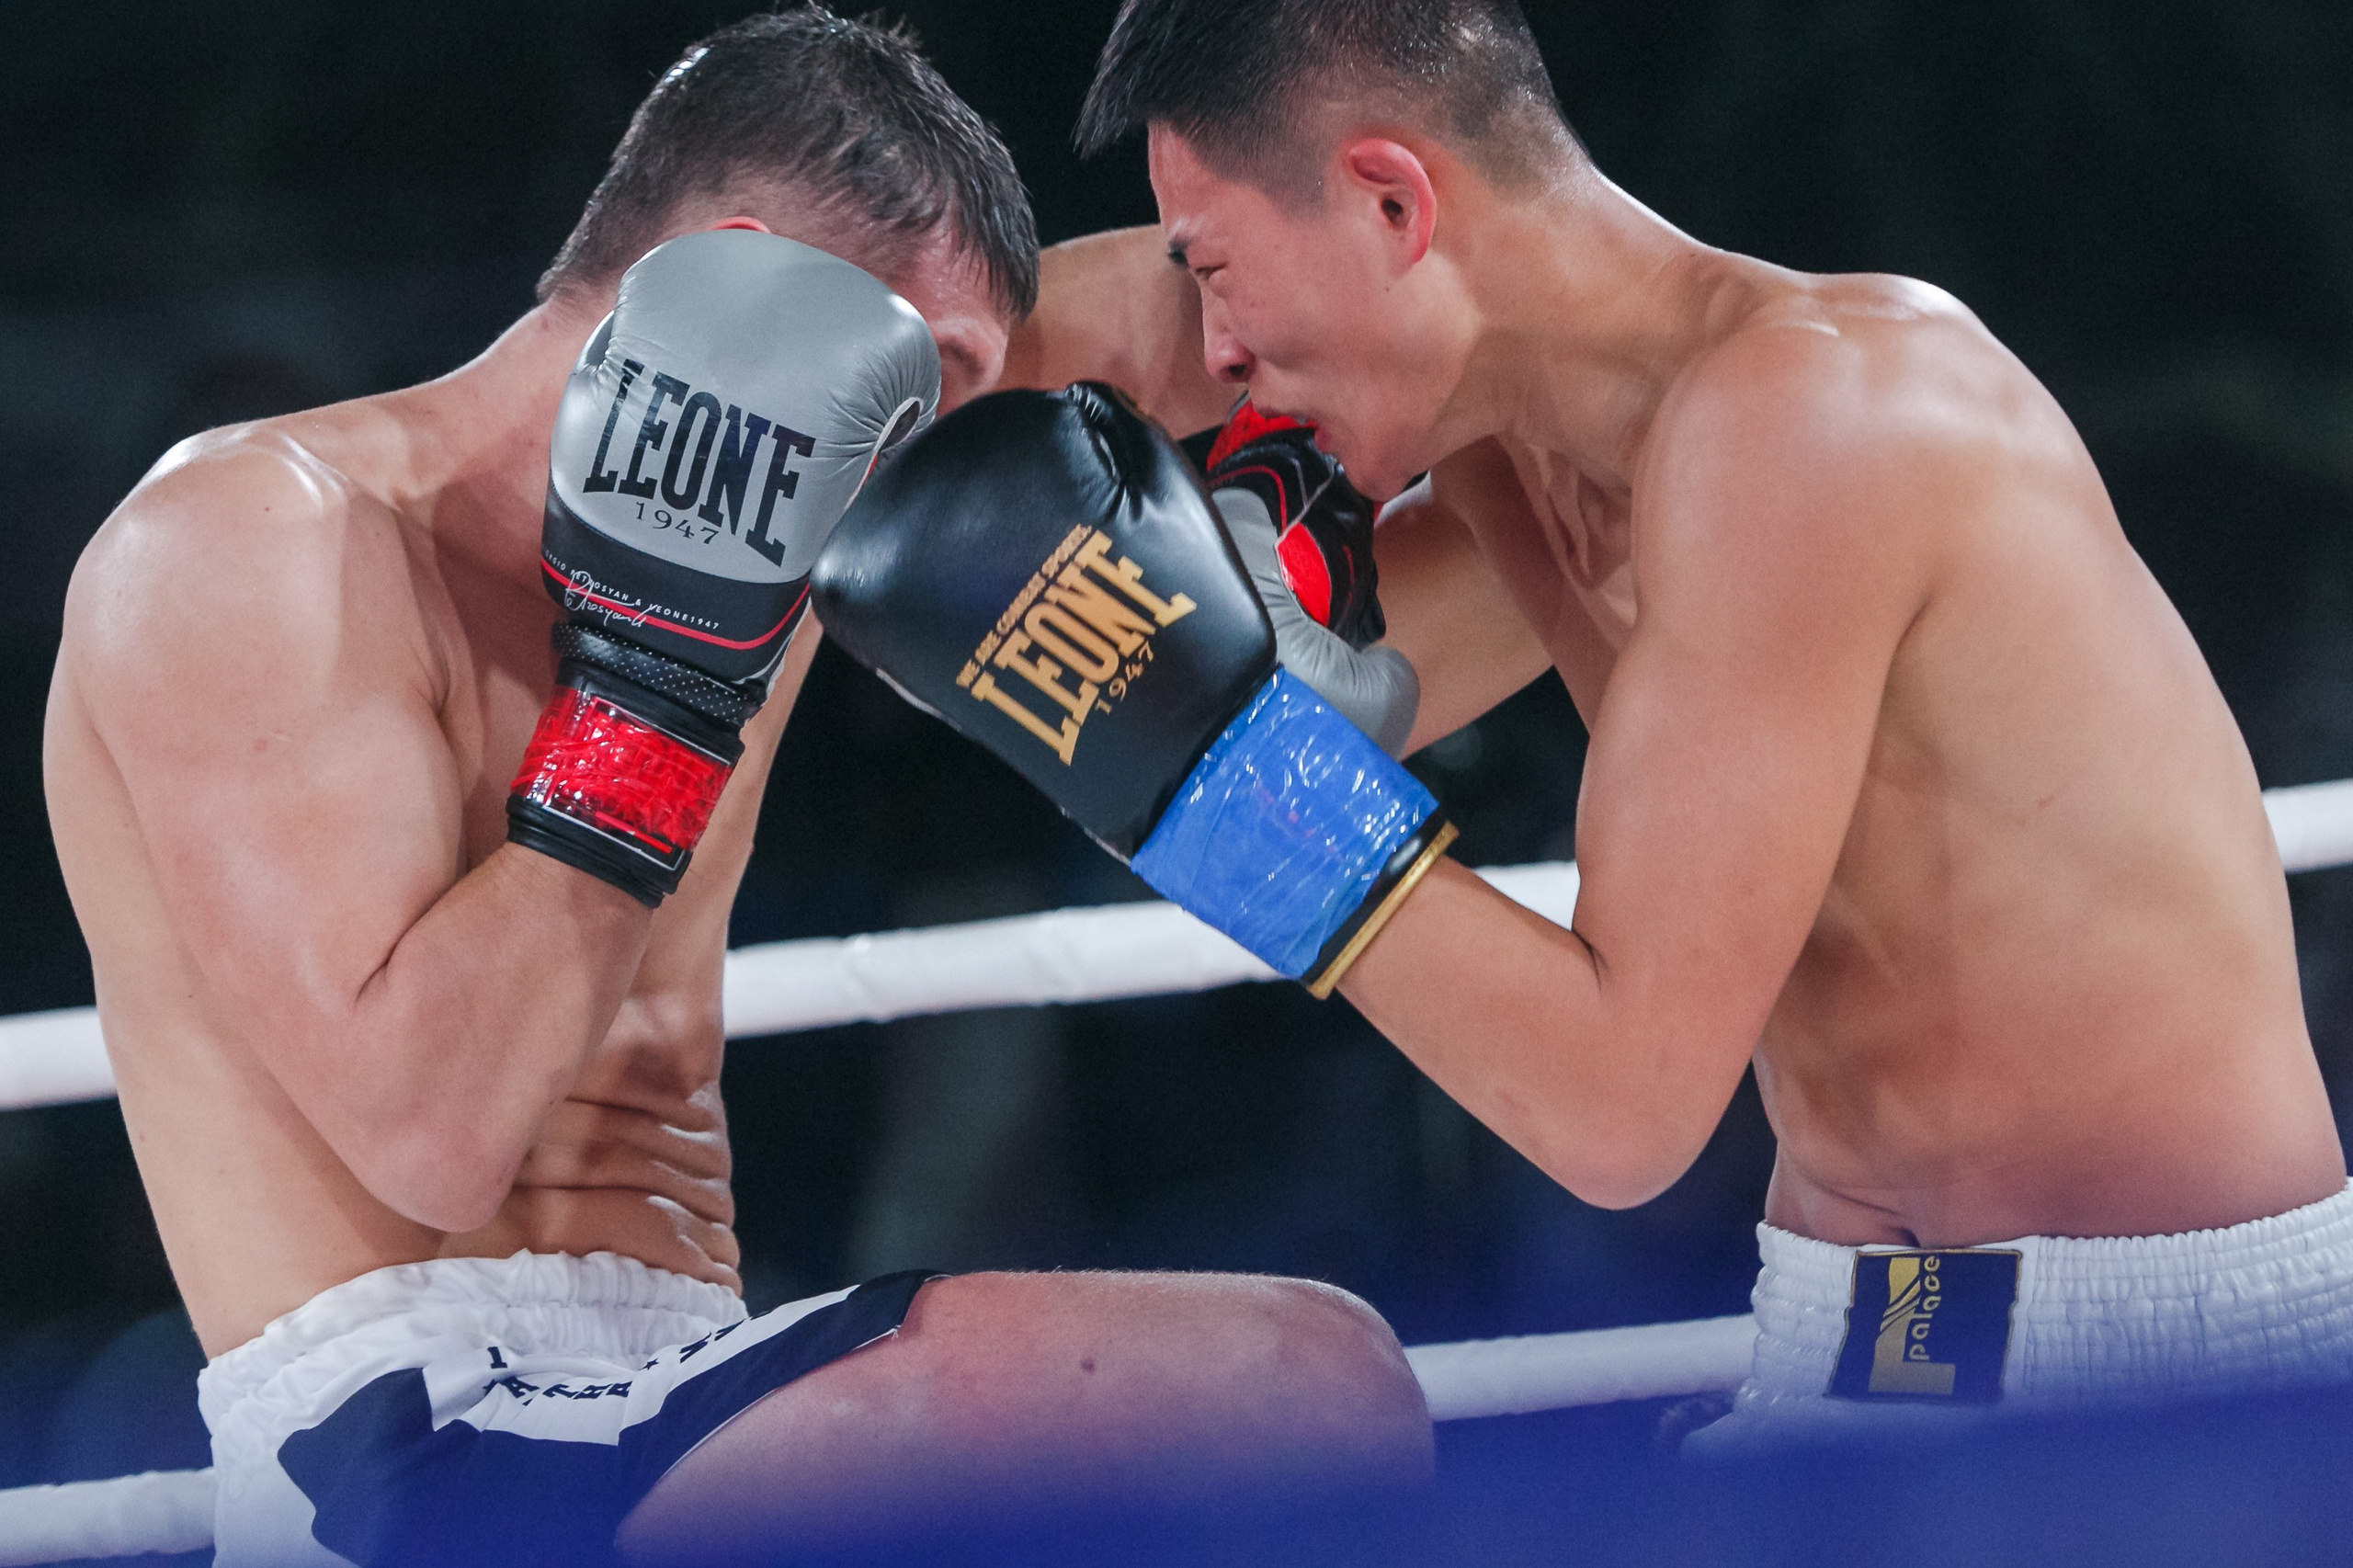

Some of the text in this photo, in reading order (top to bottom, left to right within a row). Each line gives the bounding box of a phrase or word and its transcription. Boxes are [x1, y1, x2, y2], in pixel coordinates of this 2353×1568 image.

[583, 358, 816, 567] LEONE
[635, 501, 720, 544] 1947
[972, 529, 1197, 767] LEONE
[1095, 641, 1154, 715] 1947
[1909, 1256, 1941, 1360] palace
